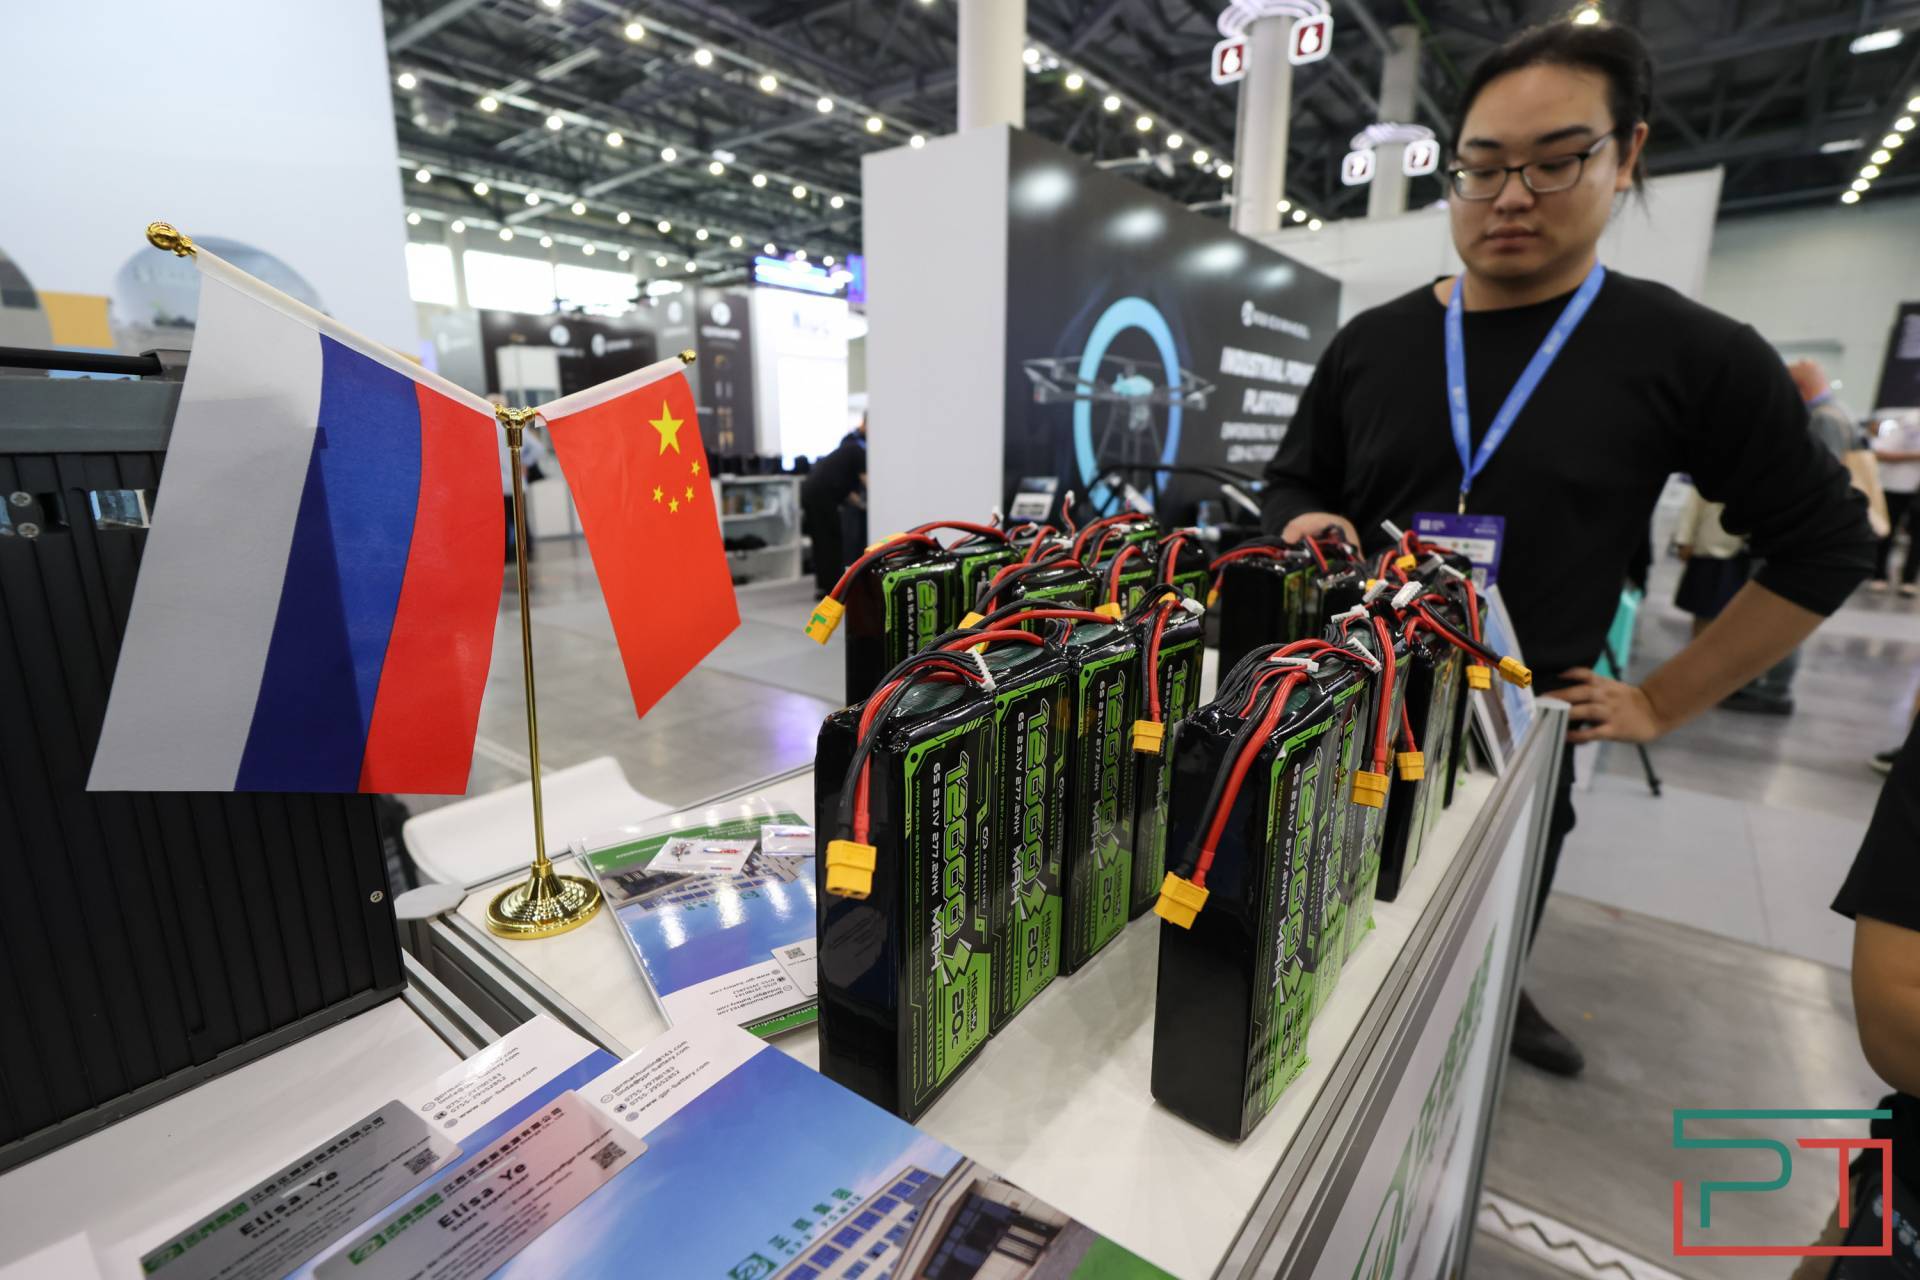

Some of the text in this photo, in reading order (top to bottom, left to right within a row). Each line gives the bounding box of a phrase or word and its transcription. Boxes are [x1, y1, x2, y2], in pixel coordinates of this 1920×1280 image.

[1013, 712, 1024, 835] 6S 23.1V 277.2WH
[1101, 670, 1125, 837] 12000
[1293, 762, 1301, 784] 6S
[1023, 698, 1050, 885] 12000
[1090, 799, 1101, 854] MAH
[1287, 790, 1298, 831] 23.1V
[931, 762, 941, 896] 6S 23.1V 277.2WH
[943, 751, 970, 939] 12000
[1284, 746, 1323, 962] 12000
[1011, 843, 1023, 906] MAH
[931, 904, 943, 972] MAH
[1273, 916, 1288, 988] MAH
[239, 1195, 301, 1236] Elisa
[308, 1171, 338, 1189] Ye
[437, 1163, 527, 1229] Elisa Ye
